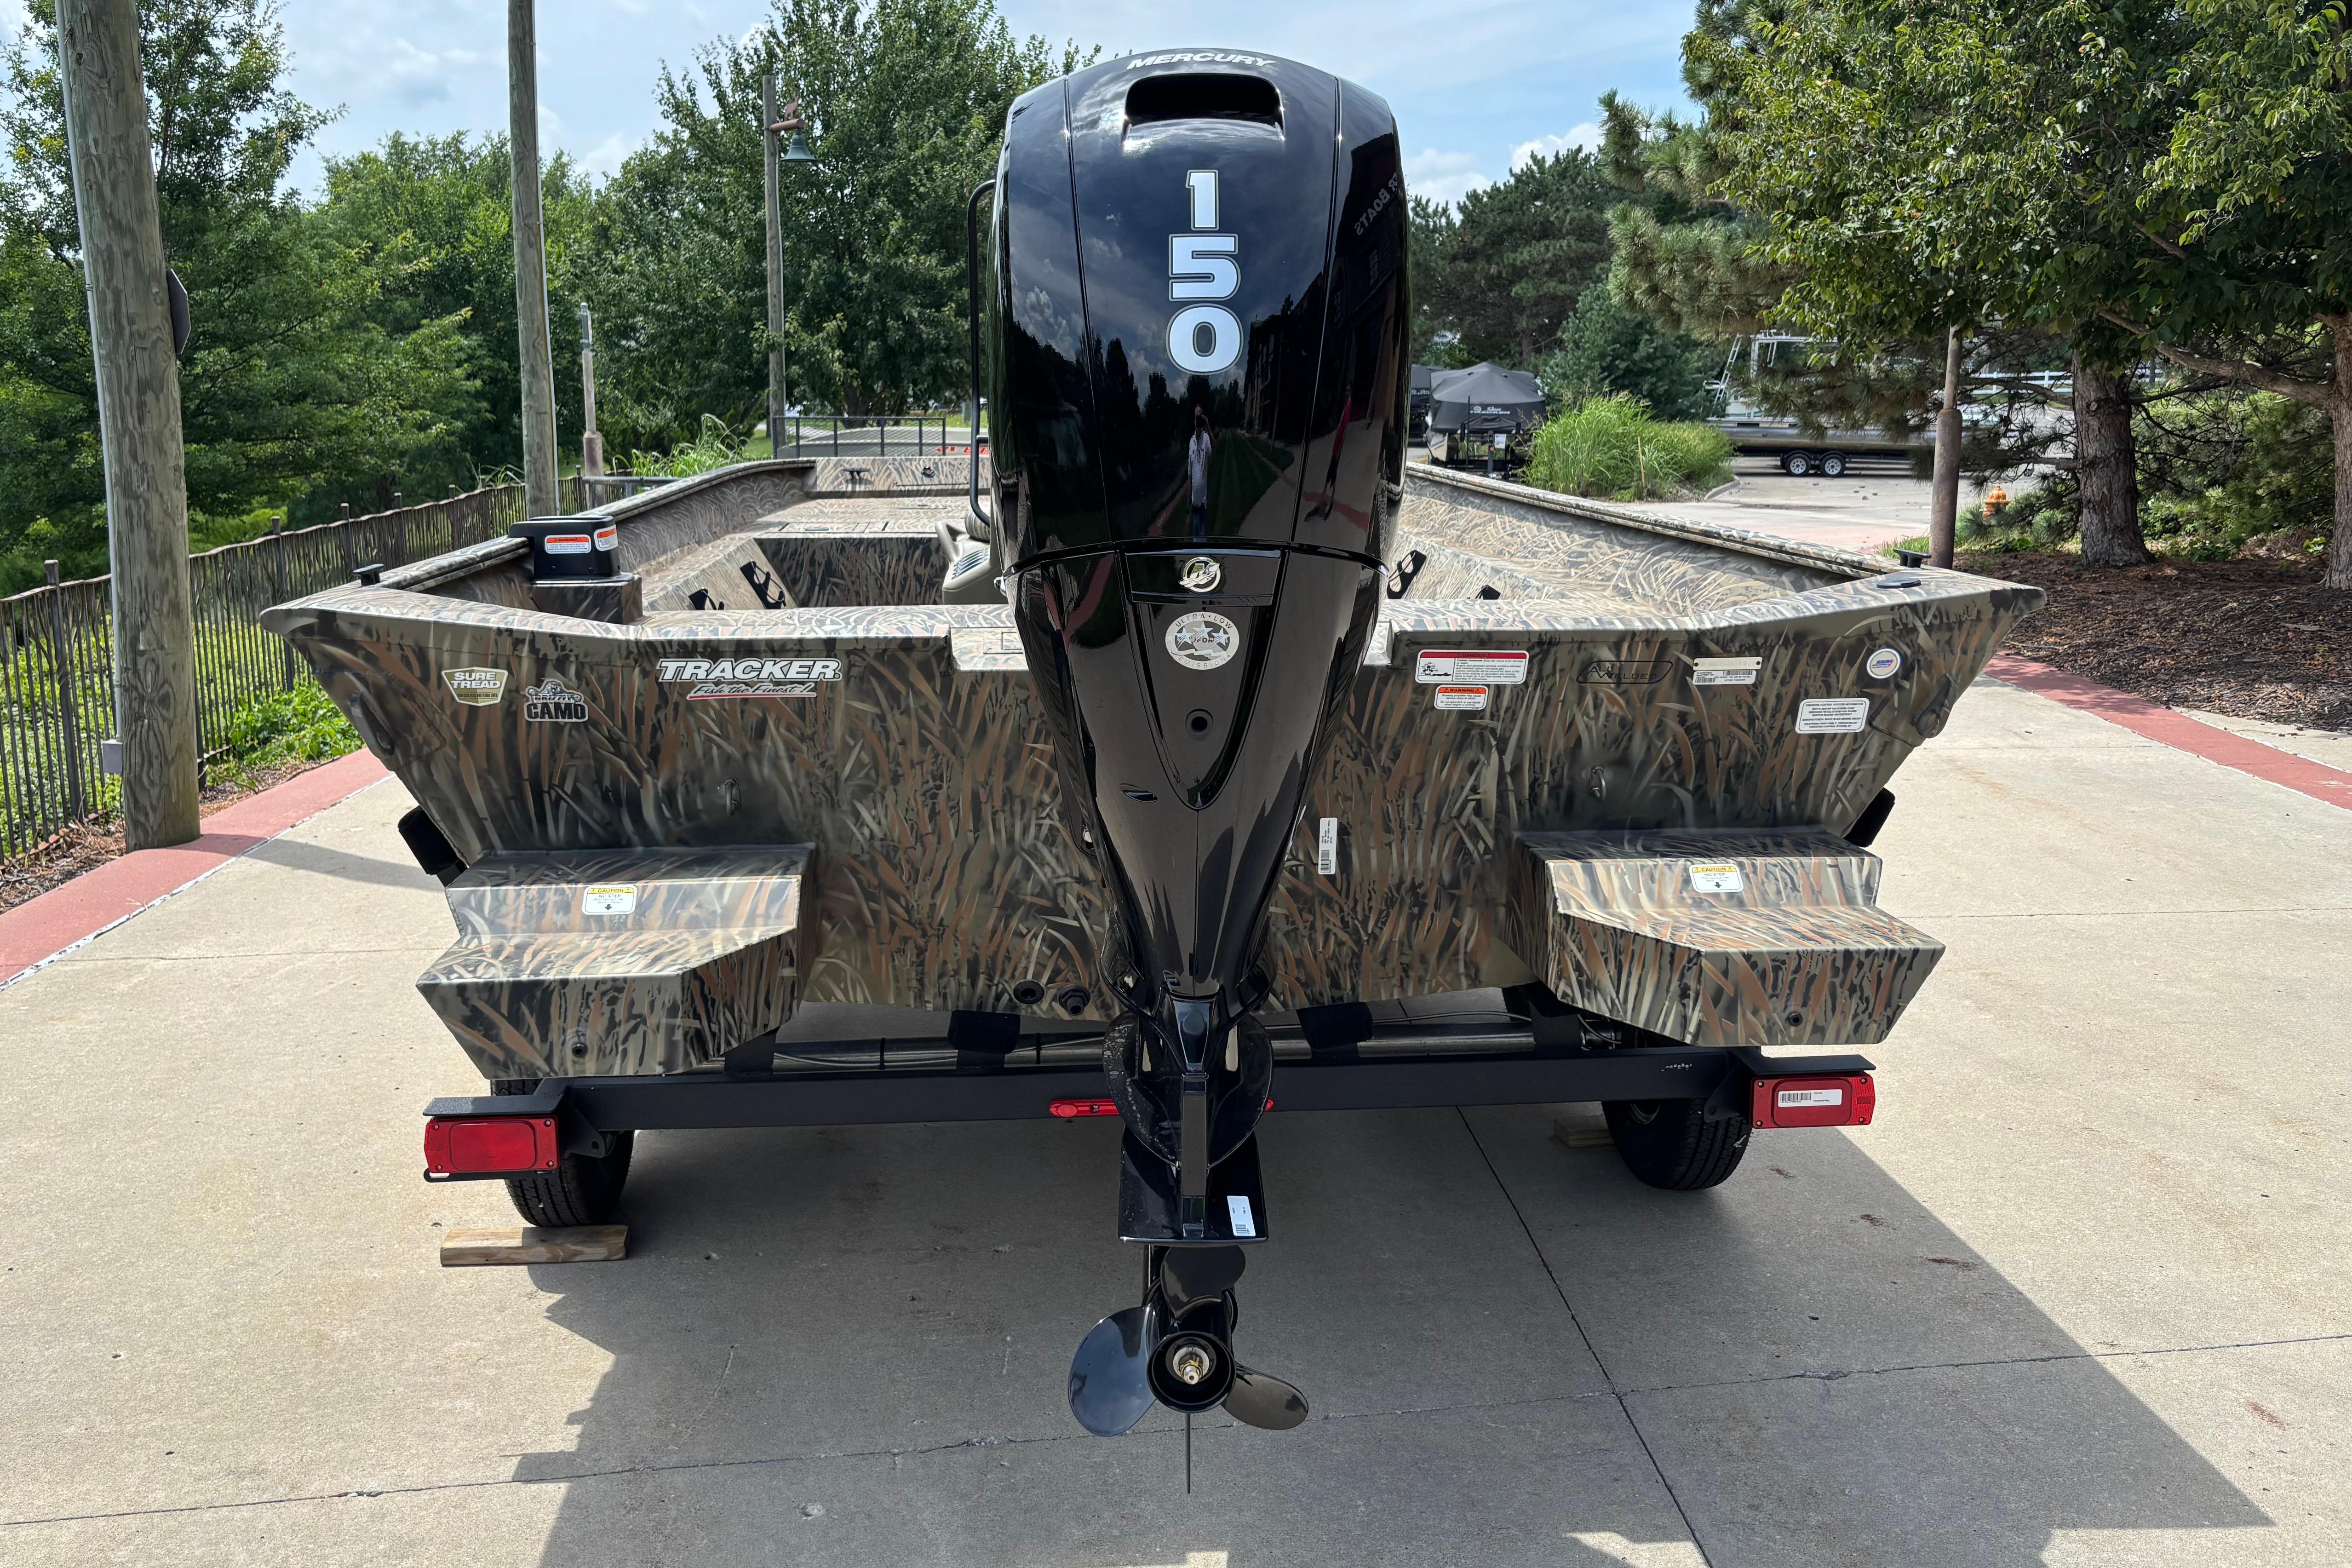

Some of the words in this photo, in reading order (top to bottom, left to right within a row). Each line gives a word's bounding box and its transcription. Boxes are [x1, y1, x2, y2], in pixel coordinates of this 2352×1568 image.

[1126, 52, 1278, 70] MERCURY
[1166, 170, 1244, 375] 150
[1175, 613, 1205, 627] ULTRA
[1214, 615, 1233, 629] LOW
[659, 660, 838, 680] TRACKER
[1178, 656, 1227, 668] EMISSION
[451, 680, 501, 689] TREAD
[454, 672, 497, 681] SURE
[694, 684, 725, 694] Fish
[729, 684, 751, 694] the
[526, 703, 586, 720] CAMO
